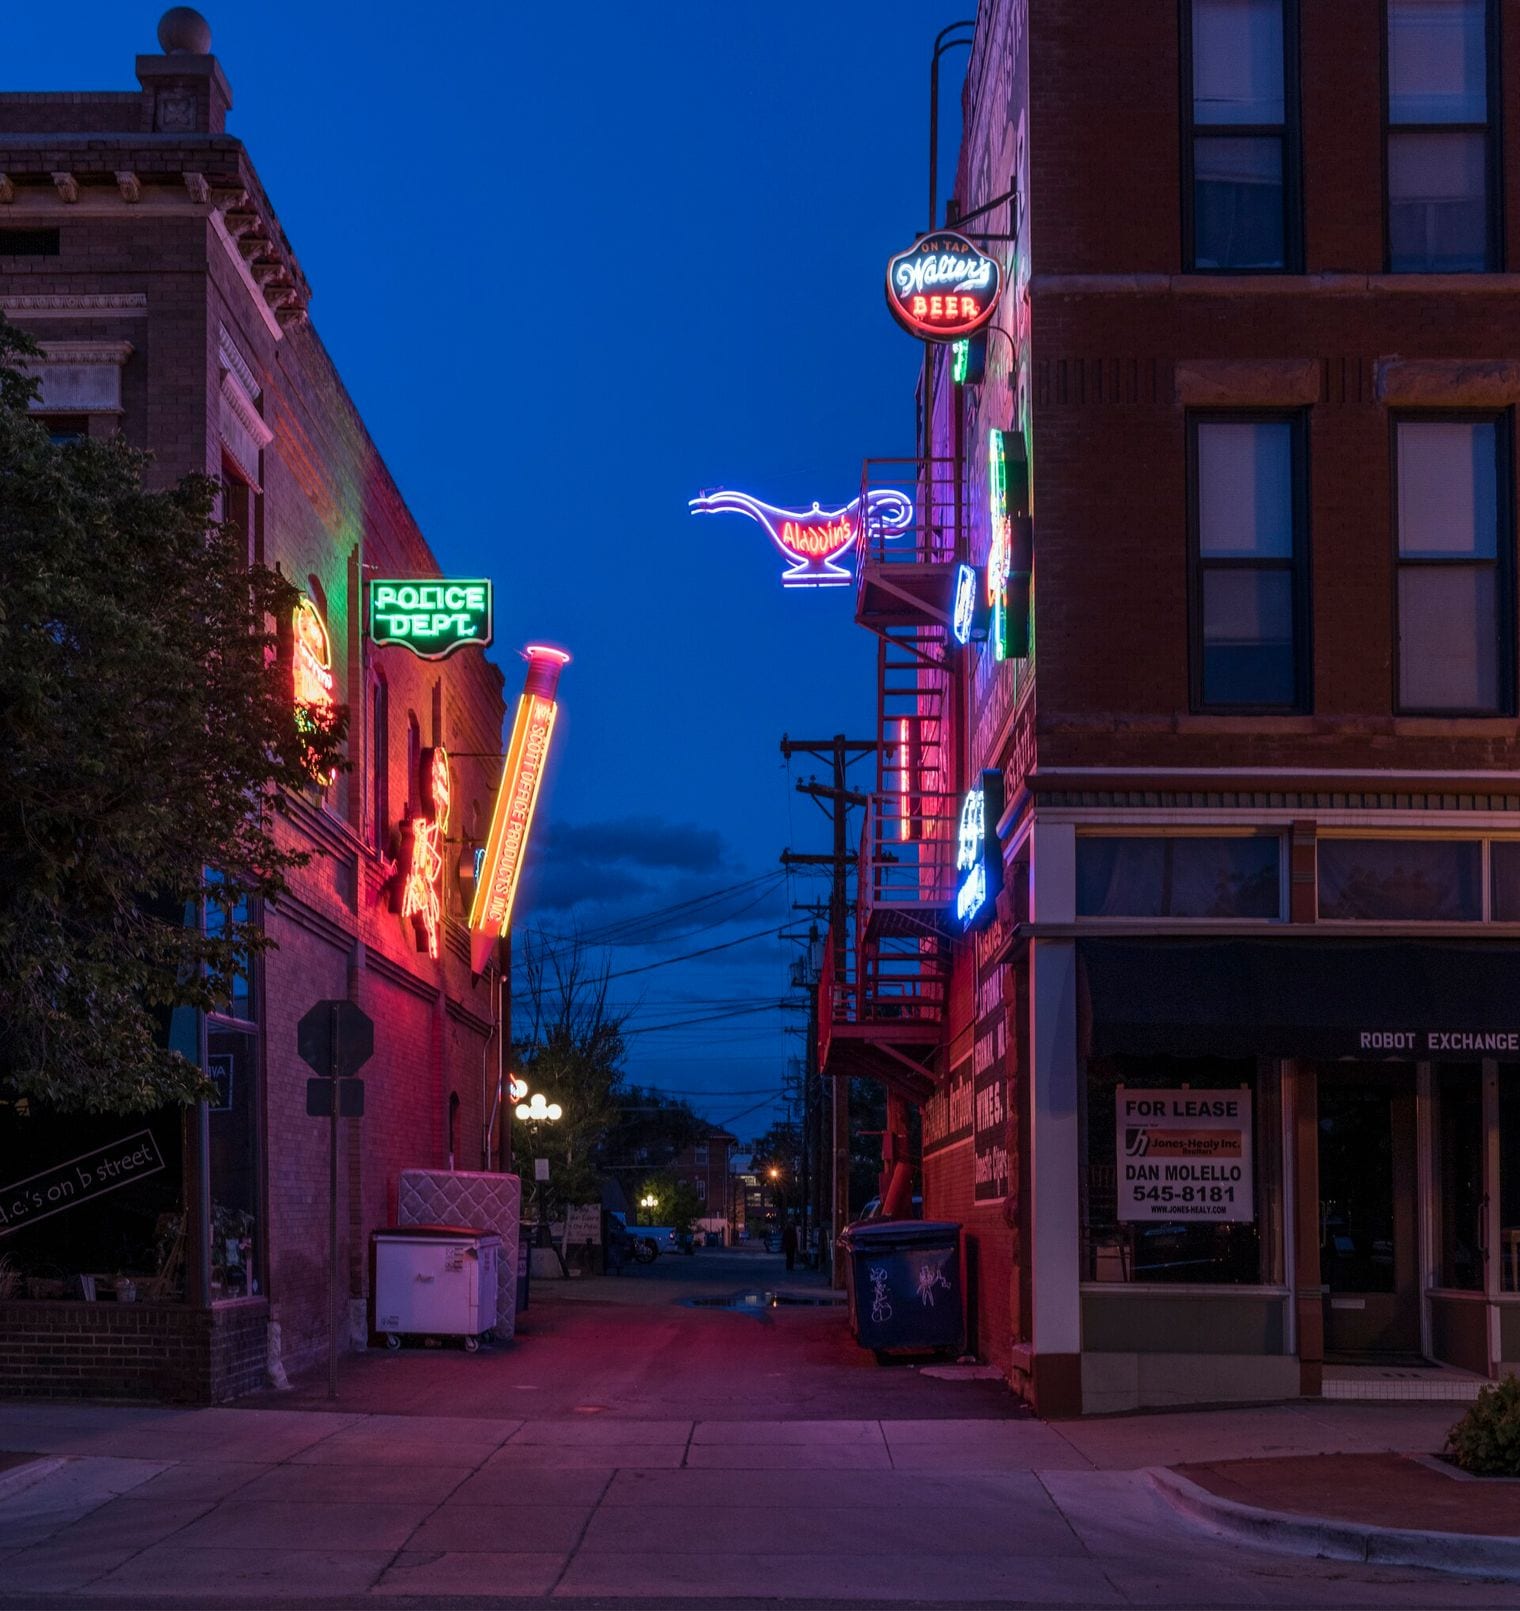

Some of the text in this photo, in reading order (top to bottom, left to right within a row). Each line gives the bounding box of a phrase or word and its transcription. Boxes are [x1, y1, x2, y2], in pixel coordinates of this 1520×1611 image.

[921, 241, 969, 253] ON TAP
[896, 254, 991, 299] Walter's
[913, 295, 979, 318] BEER
[783, 515, 851, 553] Aladdin's
[376, 586, 485, 610] POLICE
[523, 724, 545, 769] SCOTT
[512, 771, 535, 820] OFFICE
[496, 820, 523, 894] PRODUCTS
[1360, 1032, 1519, 1050] ROBOT EXCHANGE
[1126, 1101, 1238, 1117] FOR LEASE
[1152, 1139, 1241, 1150] Jones-Healy Inc.
[47, 1181, 75, 1201] on
[76, 1167, 92, 1189] b
[96, 1144, 153, 1181] street
[1126, 1164, 1242, 1181] DAN MOLELLO
[1133, 1186, 1235, 1202] 545-8181
